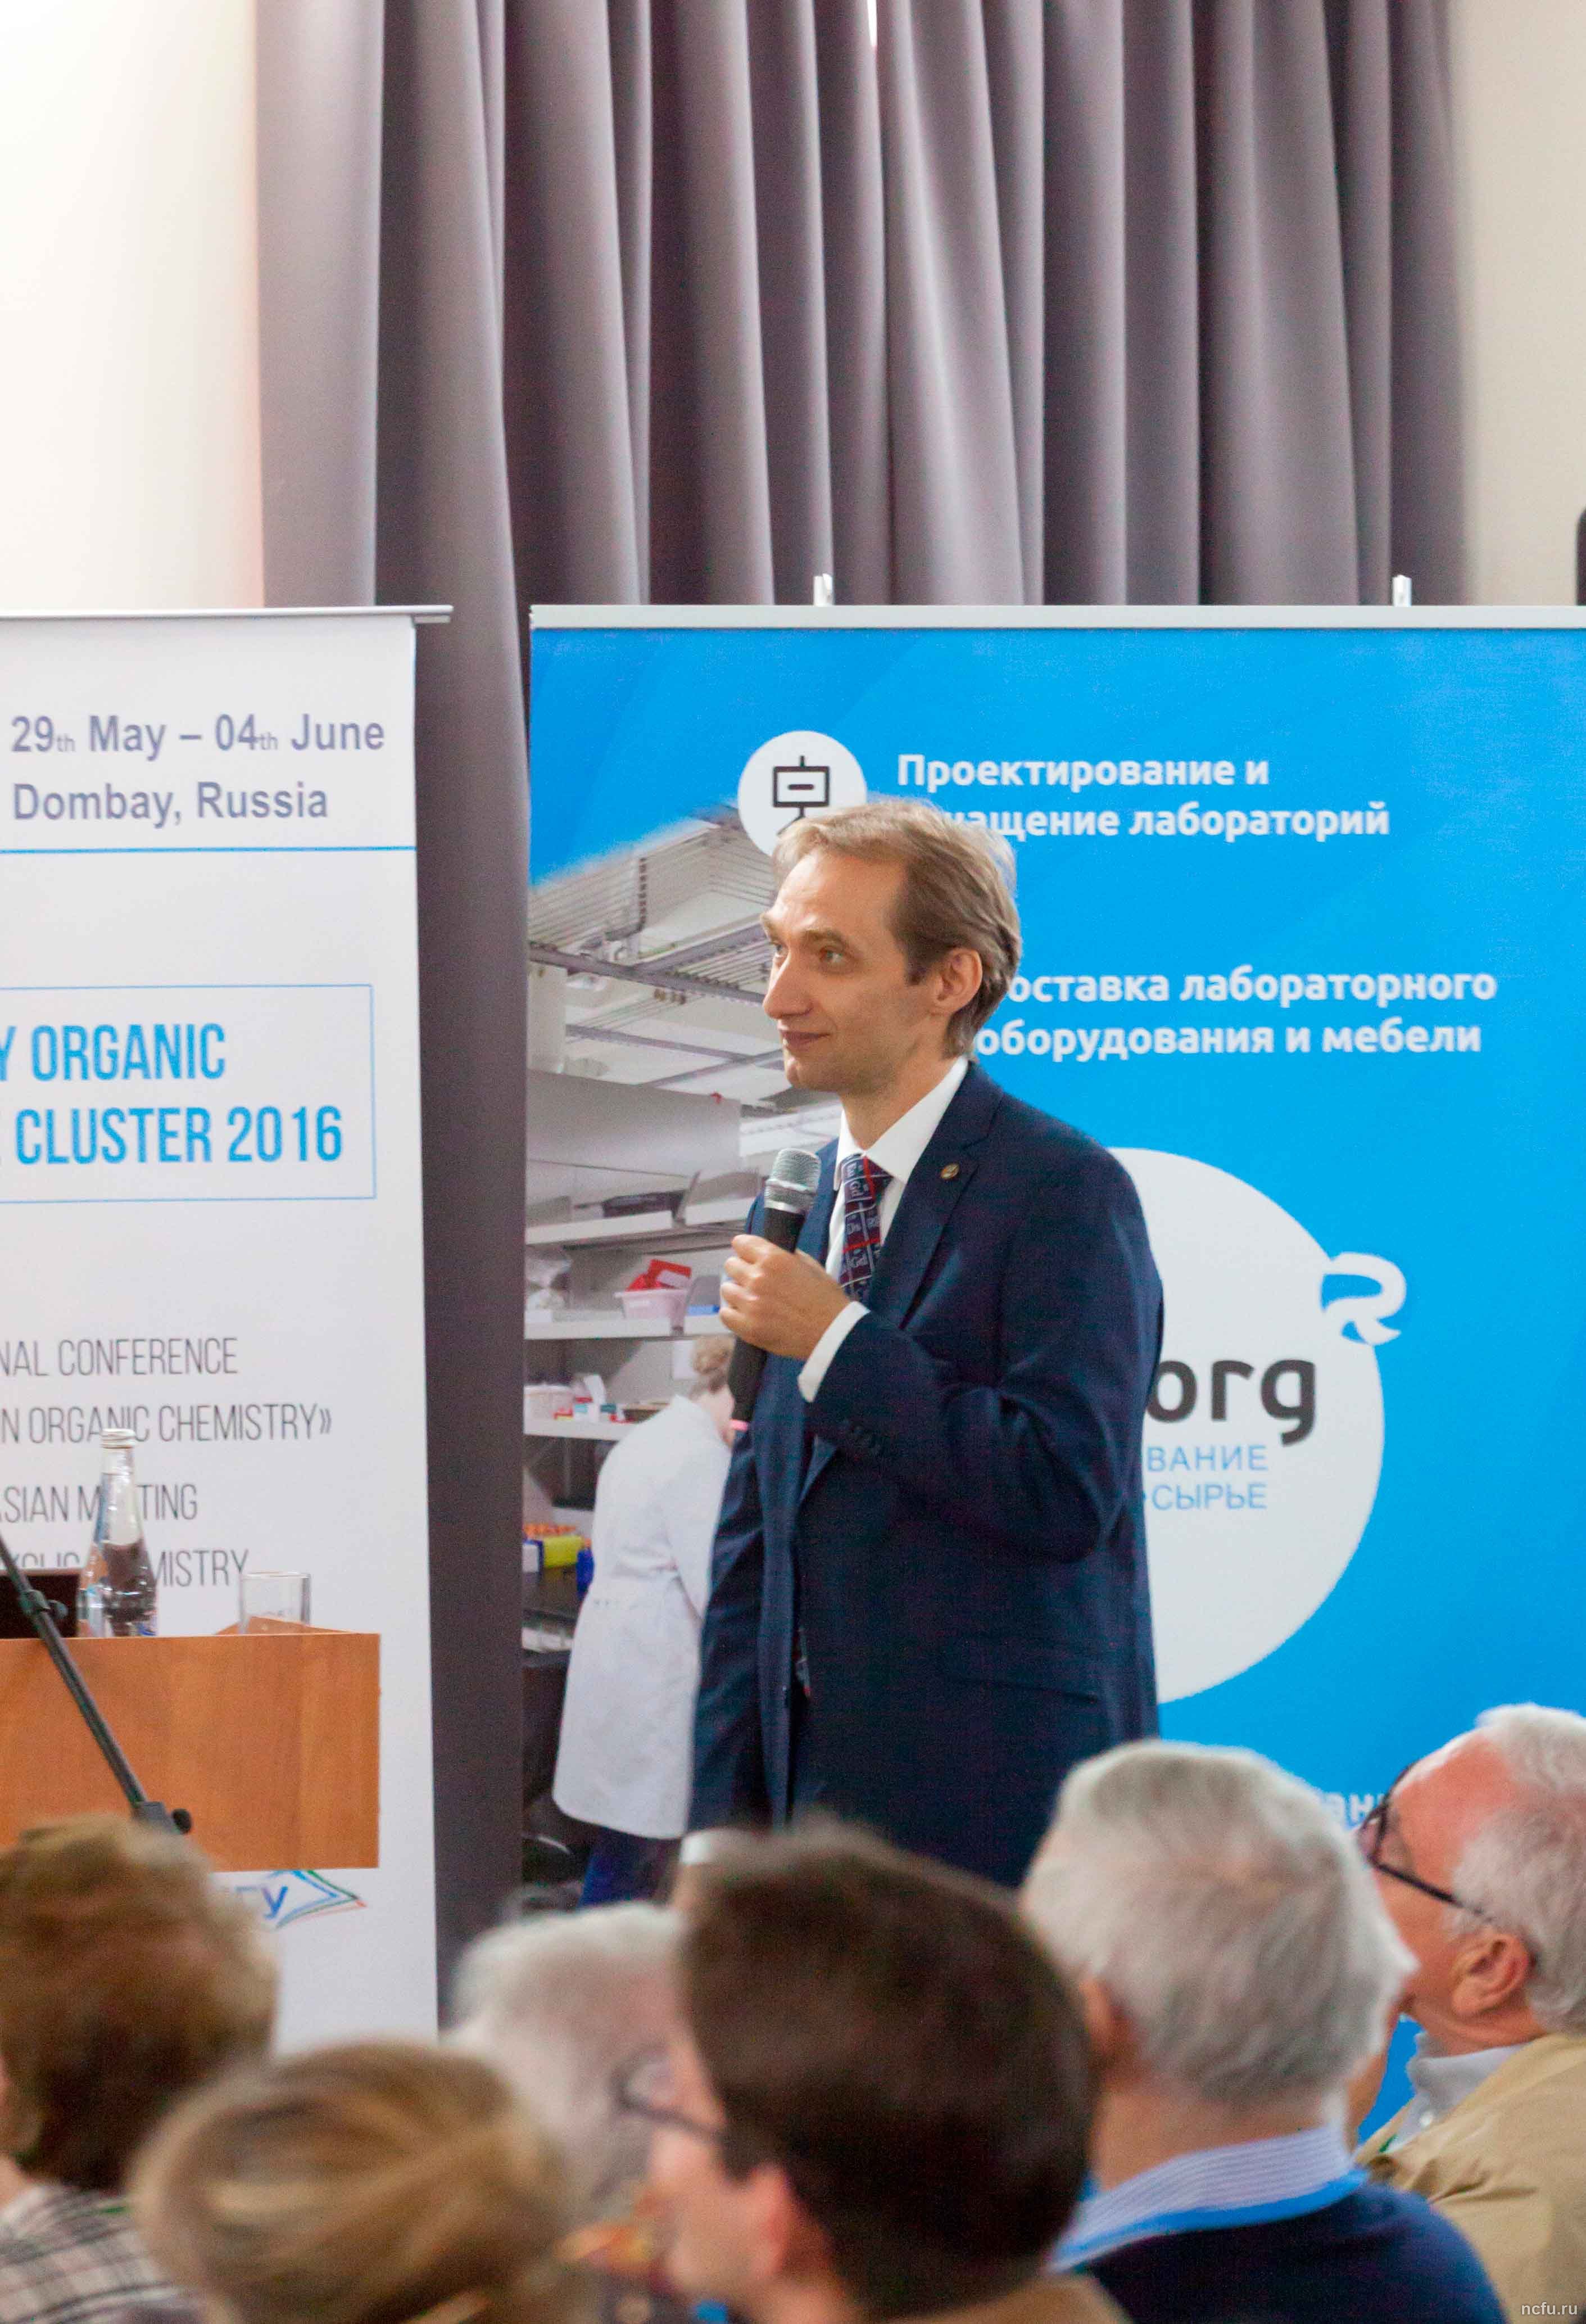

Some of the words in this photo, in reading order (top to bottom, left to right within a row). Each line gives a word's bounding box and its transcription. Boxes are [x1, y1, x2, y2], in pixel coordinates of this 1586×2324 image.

[89, 715, 166, 762] May
[291, 713, 385, 751] June
[898, 754, 1235, 793] Проектирование
[1245, 760, 1269, 785] и
[13, 783, 181, 829] Dombay,
[197, 781, 328, 819] Russia
[1129, 801, 1389, 843] лабораторий
[1009, 975, 1170, 1002] оставка
[1180, 964, 1498, 1008] лабораторного
[31, 1023, 225, 1082] ORGANIC
[975, 1019, 1275, 1062] оборудования
[1285, 1027, 1311, 1053] и
[1322, 1016, 1481, 1052] мебели
[16, 1107, 212, 1165] CLUSTER
[226, 1105, 342, 1162] 2016
[58, 1337, 238, 1377] CONFERENCE
[1147, 1359, 1315, 1446] org
[29, 1405, 150, 1444] ORGANIC
[1146, 1445, 1268, 1472] ВАНИЕ
[78, 1484, 198, 1522] MTING
[1151, 1482, 1267, 1511] СЫРЬЕ
